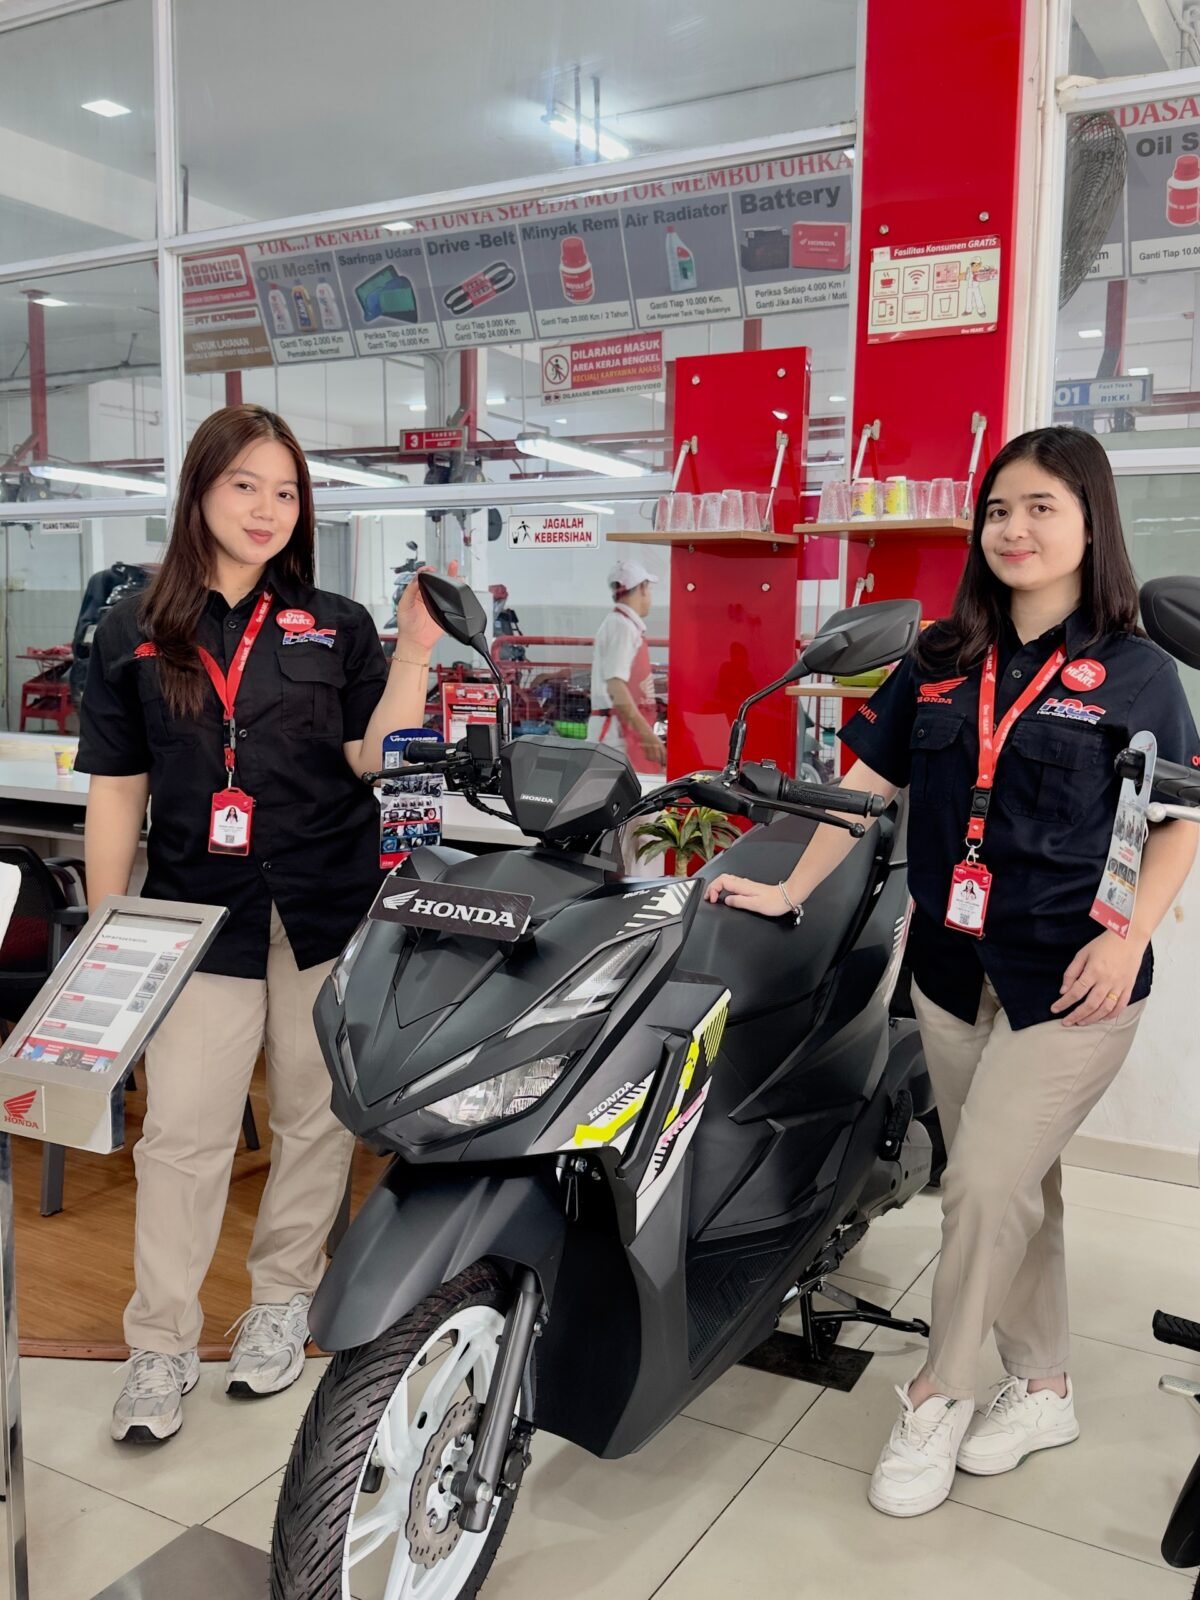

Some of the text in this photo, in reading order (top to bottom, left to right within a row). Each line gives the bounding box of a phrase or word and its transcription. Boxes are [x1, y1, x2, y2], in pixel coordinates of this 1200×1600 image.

[1136, 136, 1172, 157] Oil
[740, 186, 840, 215] Battery
[314, 229, 382, 249] KENALI
[498, 198, 579, 223] SEPEDA
[625, 203, 728, 229] Air Radiator
[522, 217, 619, 241] Minyak Rem
[427, 235, 469, 256] Drive
[893, 246, 925, 257] Fasilitas
[925, 243, 967, 253] Konsumen
[967, 236, 998, 249] GRATIS
[338, 247, 422, 268] Saringa Udara
[1139, 248, 1161, 261] Ganti
[1163, 246, 1180, 259] Tiap
[258, 260, 332, 281] Oli Mesin
[755, 289, 781, 298] Periksa
[782, 286, 806, 296] Setiap
[807, 281, 827, 291] 4.000
[828, 280, 842, 288] Km
[650, 301, 668, 310] Ganti
[670, 299, 684, 309] Tiap
[685, 296, 708, 305] 10.000
[756, 300, 774, 309] Ganti
[775, 298, 789, 307] Jika
[804, 294, 826, 304] Rusak
[455, 322, 470, 331] Cuci
[472, 321, 485, 331] Tiap
[505, 317, 516, 326] Km
[557, 315, 570, 325] Tiap
[611, 310, 629, 318] Tahun
[418, 327, 429, 335] Km
[455, 327, 521, 342] Ganti Tiap 24.000 Km
[332, 335, 344, 344] Km
[418, 336, 429, 345] Km
[572, 339, 660, 361] DILARANG MASUK
[573, 353, 660, 373] AREA KERJA BENGKEL
[563, 390, 591, 400] DILARANG
[592, 386, 625, 397] MENGAMBIL
[410, 434, 418, 447] 3
[542, 517, 585, 530] JAGALAH
[534, 531, 593, 544] KEBERSIHAN
[1079, 663, 1097, 678] One
[917, 697, 953, 705] HONDA
[1039, 697, 1107, 721] HRC
[520, 793, 554, 804] HONDA
[409, 898, 516, 929] HONDA
[587, 1081, 636, 1121] HONDA
[4, 1115, 40, 1130] HONDA
